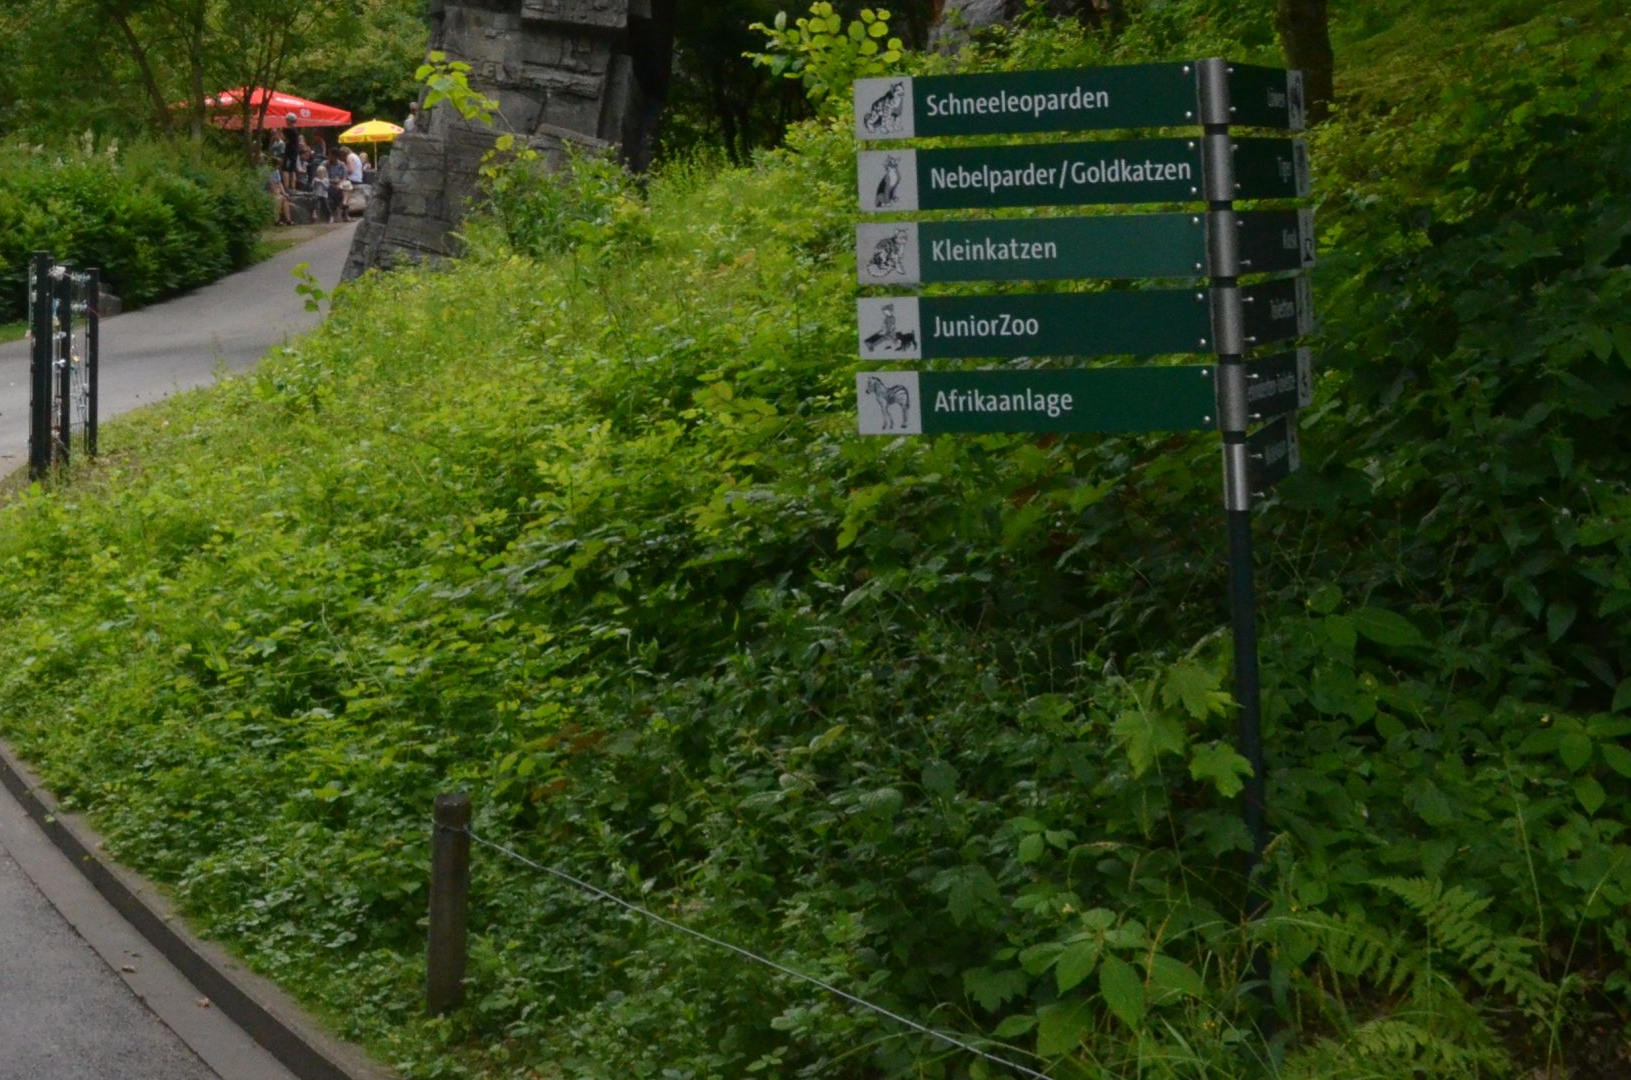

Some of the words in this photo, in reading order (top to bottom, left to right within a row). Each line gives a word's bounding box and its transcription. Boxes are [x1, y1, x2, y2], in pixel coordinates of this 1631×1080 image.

[926, 86, 1109, 117] Schneeleoparden
[932, 237, 1057, 262] Kleinkatzen
[933, 314, 1039, 338] JuniorZoo
[934, 388, 1073, 418] Afrikaanlage
